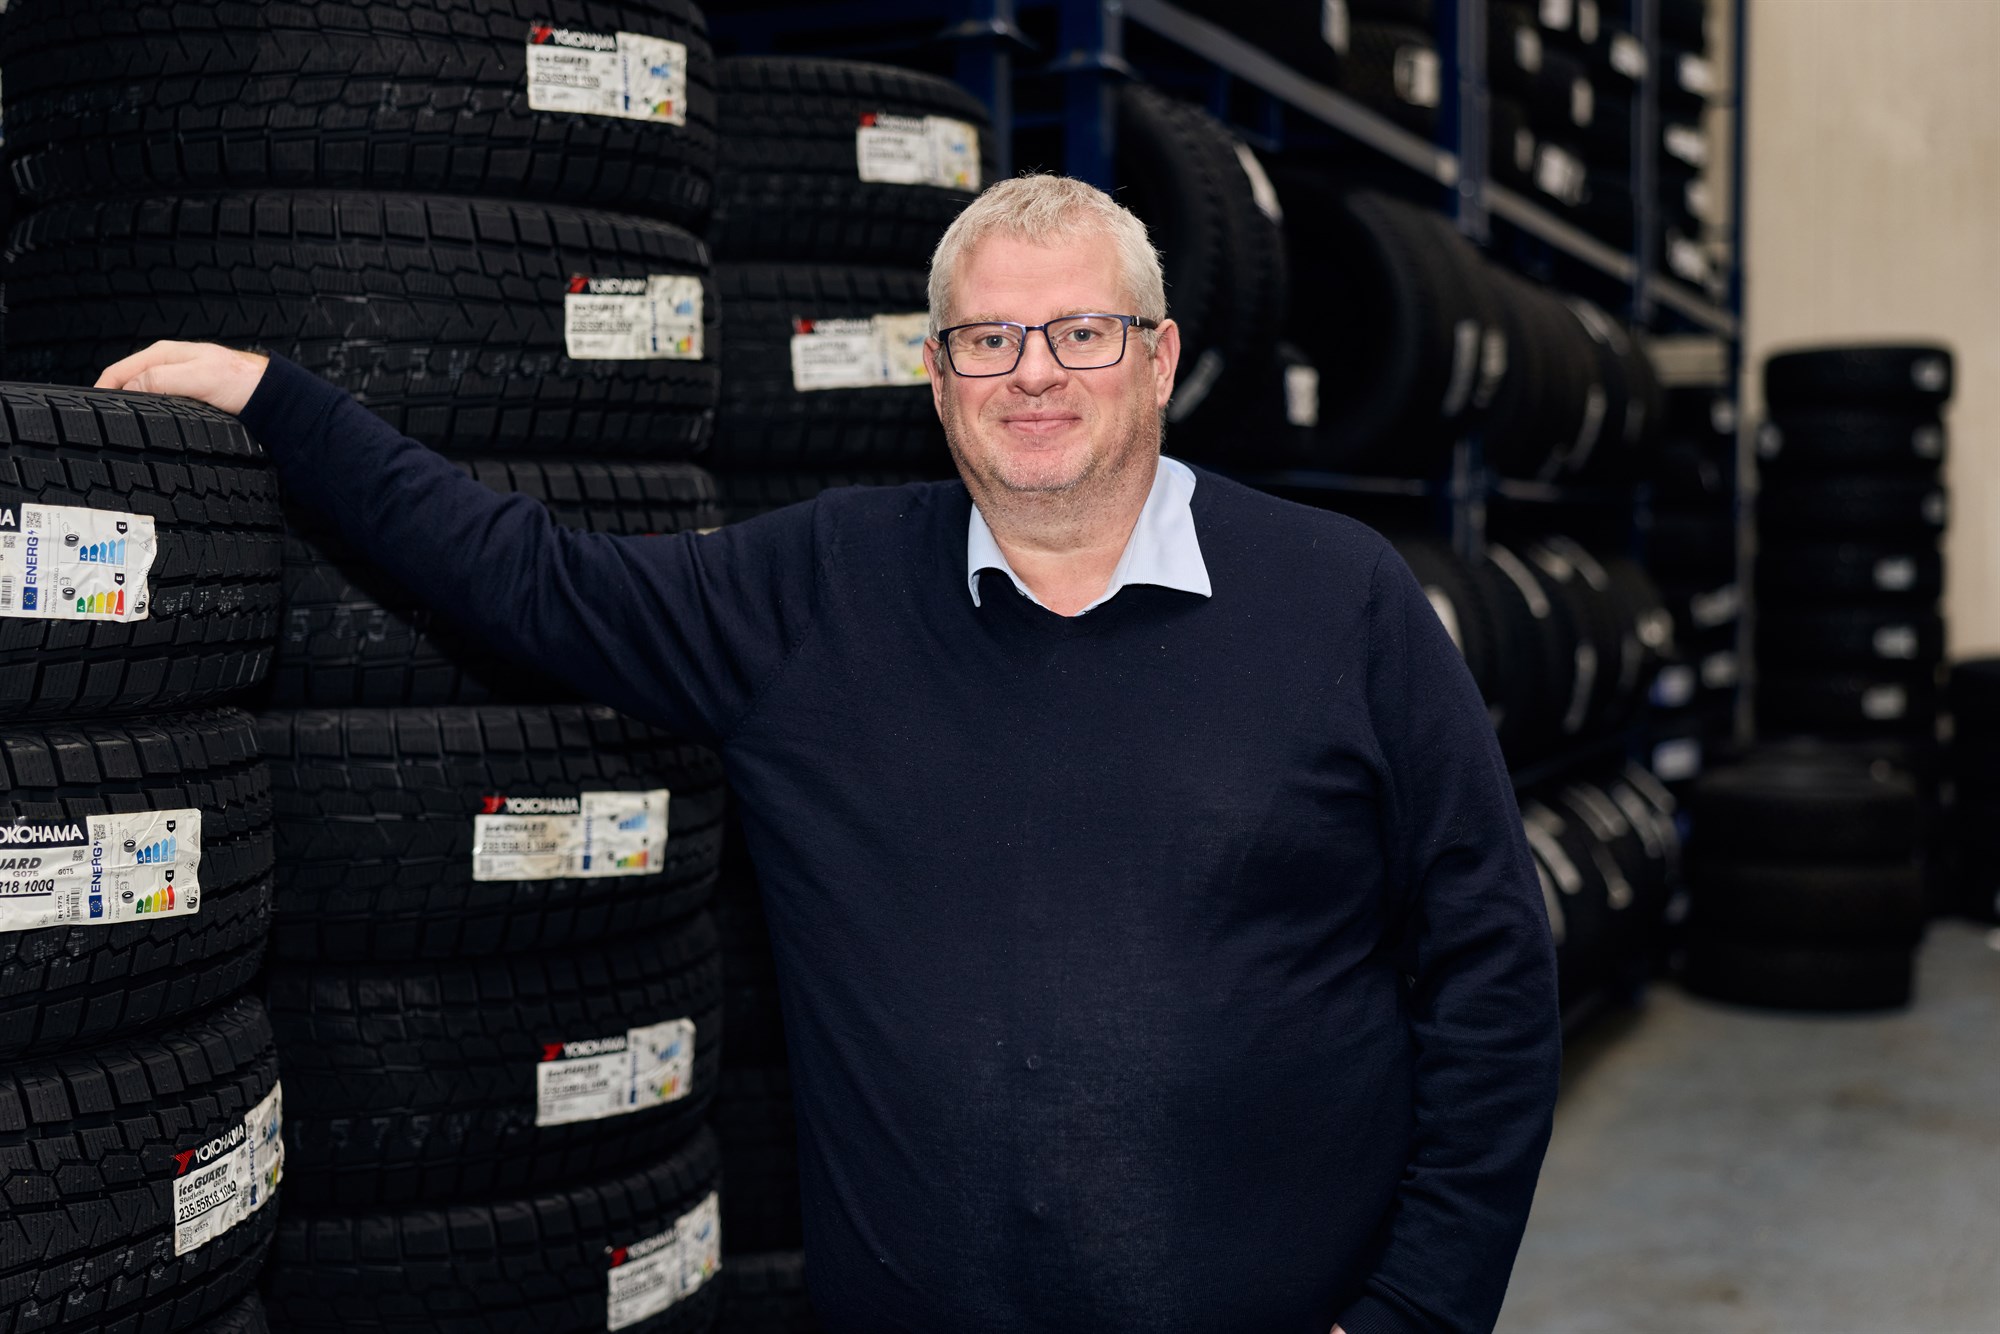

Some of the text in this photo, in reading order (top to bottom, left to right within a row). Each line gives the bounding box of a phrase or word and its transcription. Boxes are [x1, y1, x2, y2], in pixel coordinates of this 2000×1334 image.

[26, 537, 38, 585] ENERG
[506, 797, 579, 814] YOKOHAMA
[25, 879, 54, 892] 100Q
[91, 848, 103, 893] ENERG
[195, 1124, 244, 1163] YOKOHAMA
[179, 1163, 228, 1197] iceGUARD
[179, 1189, 205, 1205] Studless
